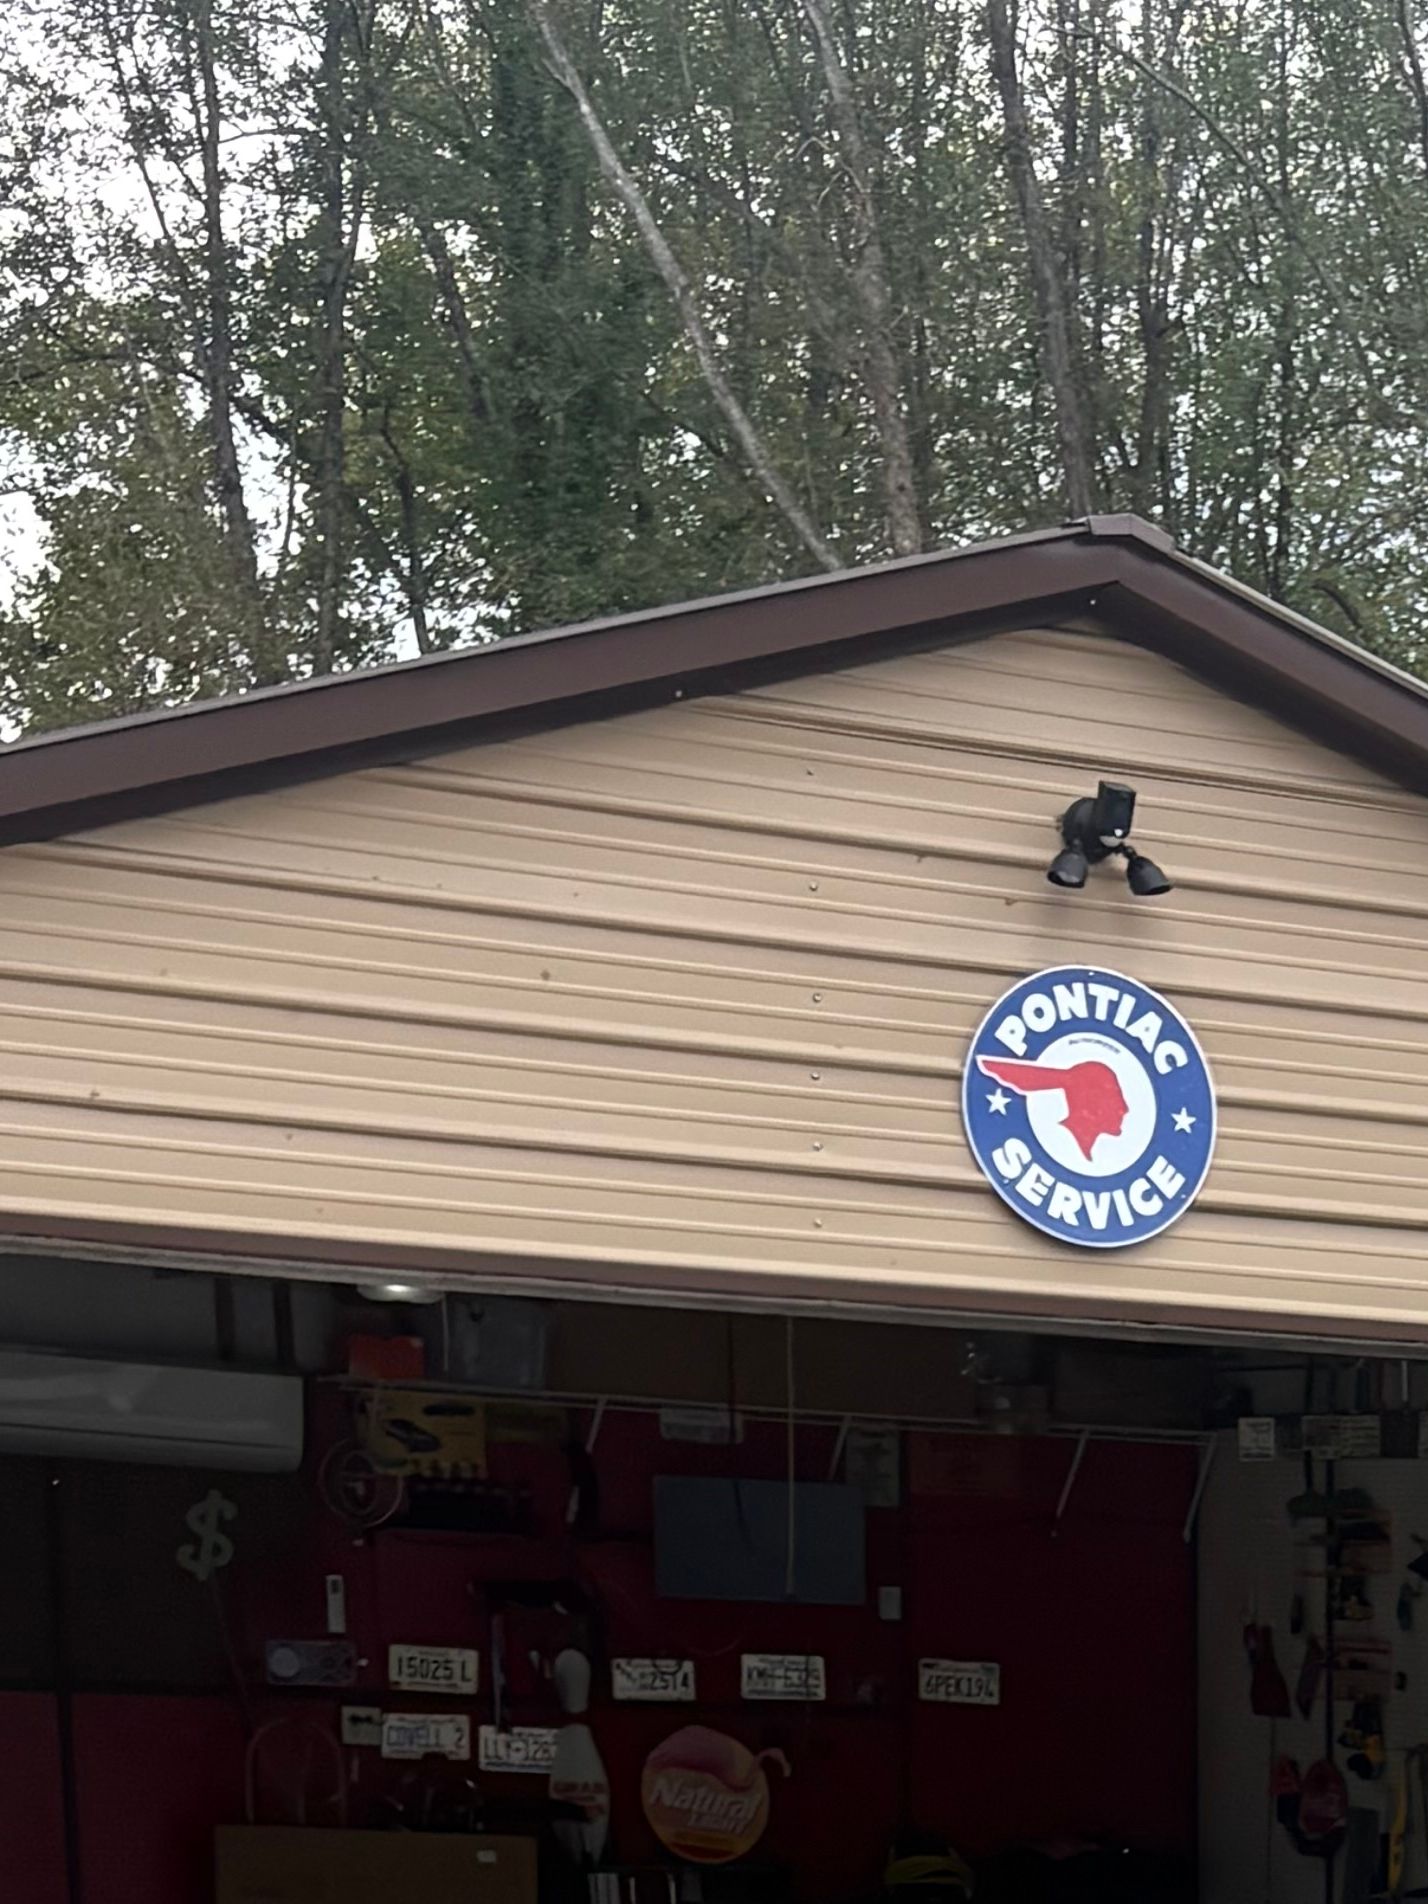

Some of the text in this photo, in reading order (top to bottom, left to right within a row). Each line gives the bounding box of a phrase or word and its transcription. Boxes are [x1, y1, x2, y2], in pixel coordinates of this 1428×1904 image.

[994, 982, 1188, 1075] PONTIAC
[992, 1137, 1187, 1229] SERVICE
[650, 1776, 762, 1822] Natural
